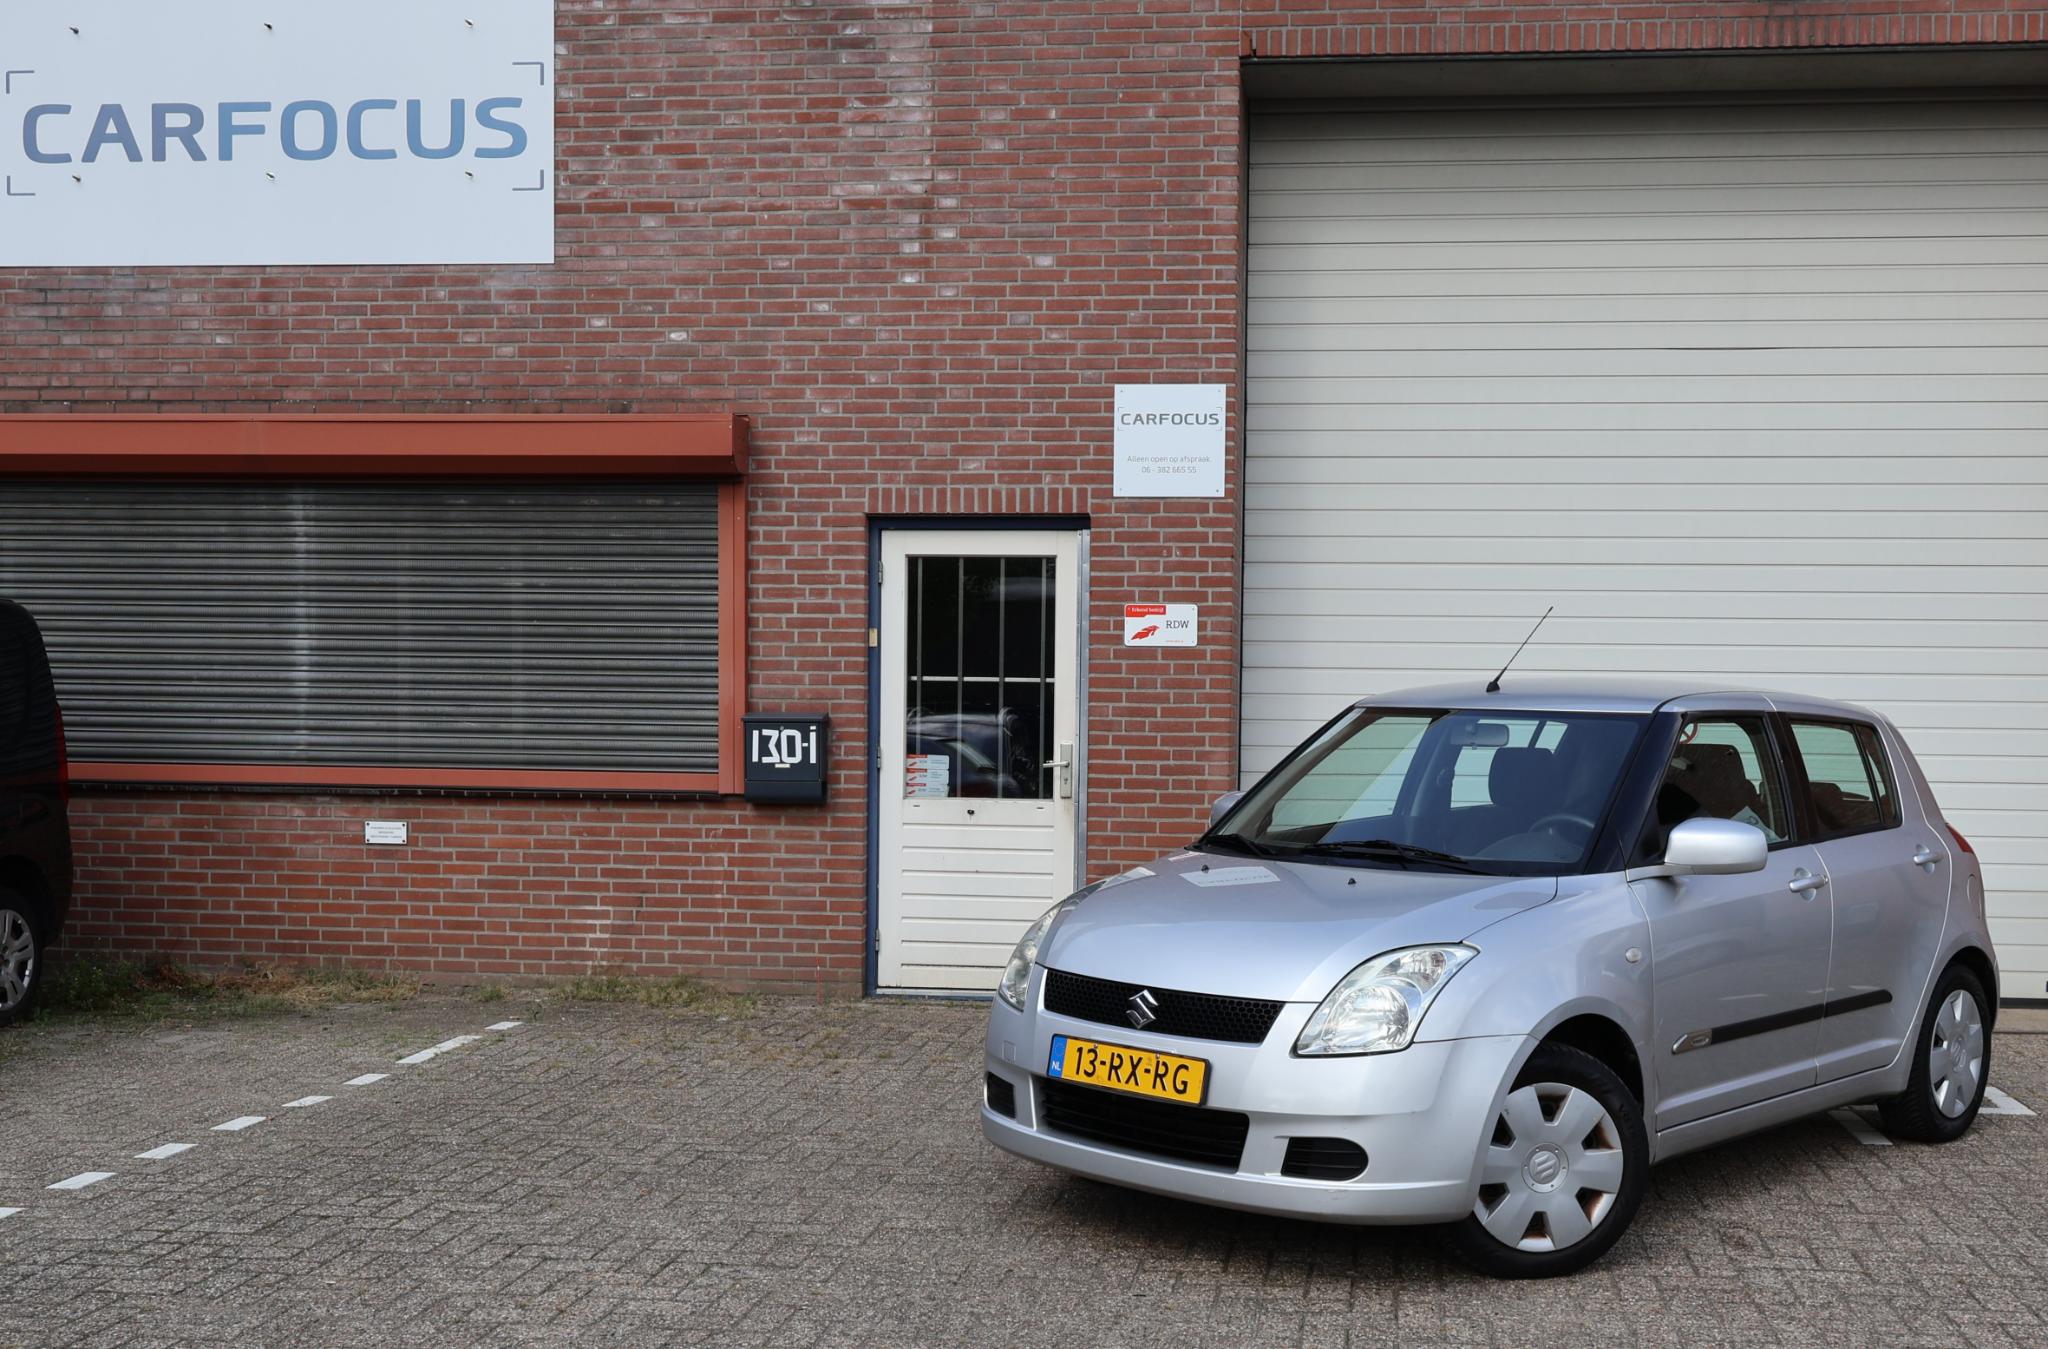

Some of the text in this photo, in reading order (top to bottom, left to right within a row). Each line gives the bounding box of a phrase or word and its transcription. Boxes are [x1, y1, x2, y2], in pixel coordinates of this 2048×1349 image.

[22, 97, 528, 164] CARFOCUS
[1121, 413, 1219, 425] CARFOCUS
[1166, 620, 1189, 629] RDW
[1051, 1060, 1061, 1071] NL
[1076, 1046, 1189, 1095] 13-RX-RG
